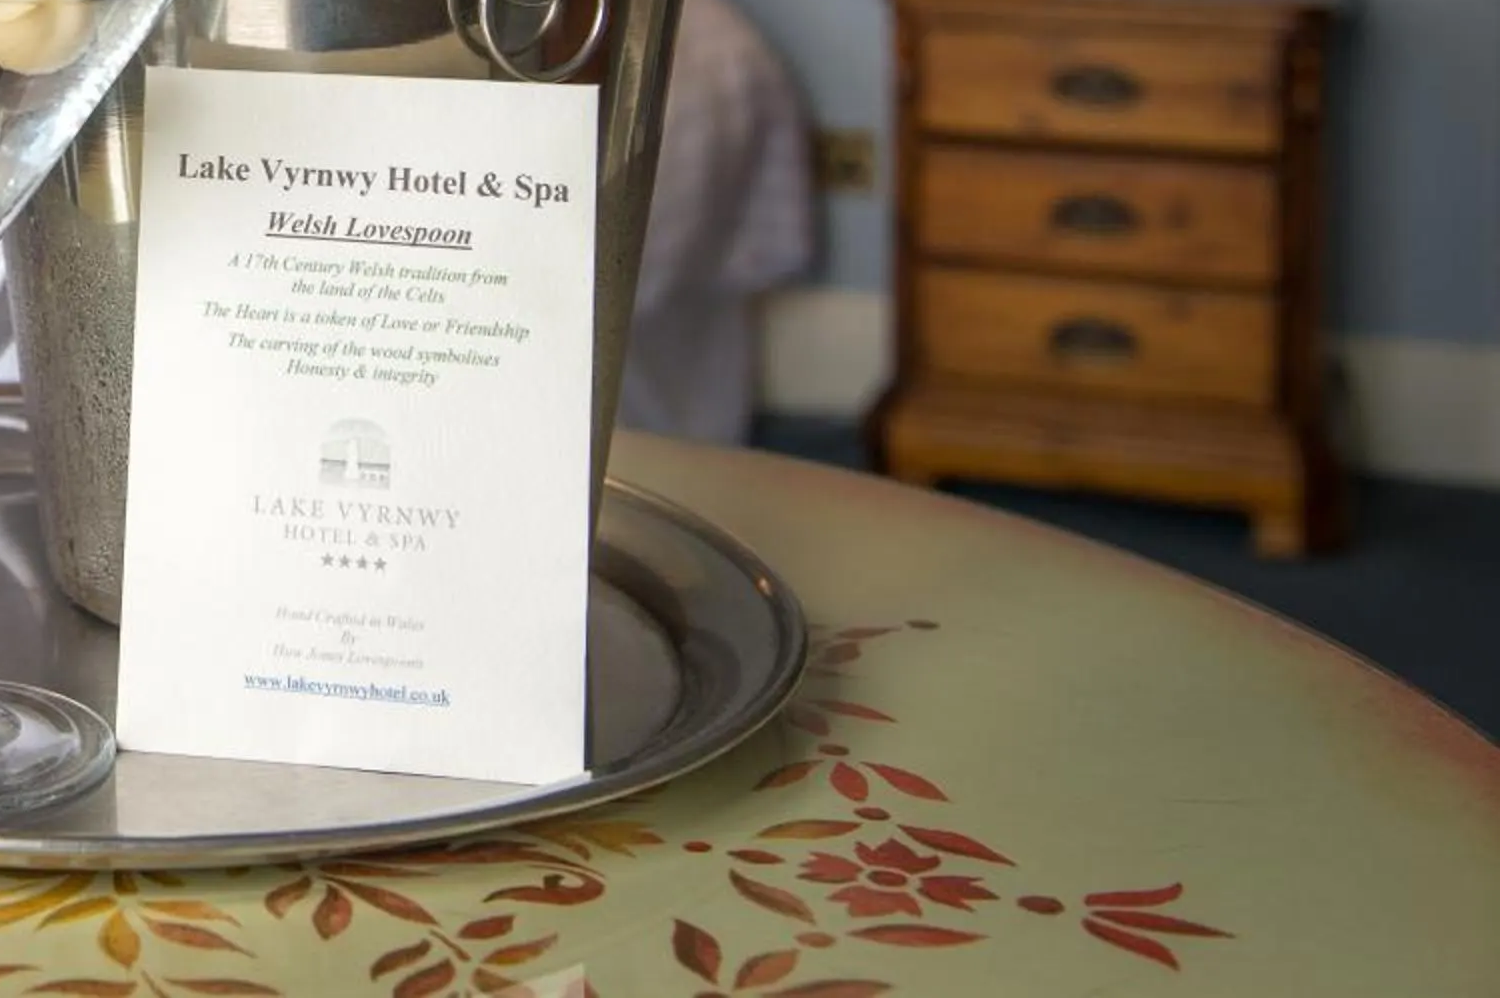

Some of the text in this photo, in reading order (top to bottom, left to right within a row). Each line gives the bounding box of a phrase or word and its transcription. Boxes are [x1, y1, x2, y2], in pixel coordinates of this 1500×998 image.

[178, 153, 570, 207] Lake Vyrnwy Hotel & Spa
[267, 211, 472, 248] Welsh Lovespoon
[228, 253, 507, 287] A 17th Century Welsh tradition from
[291, 280, 445, 304] the land of the Celts
[204, 302, 530, 341] The Heart is a token of Love or Friendship
[228, 332, 255, 349] The
[322, 338, 341, 357] of
[341, 340, 366, 357] the
[370, 344, 413, 360] wood
[416, 347, 501, 366] symbolises
[286, 358, 437, 387] Honesty & integrity
[253, 495, 461, 529] LAKE VYRNWY
[283, 523, 427, 551] HOTEL & SPA
